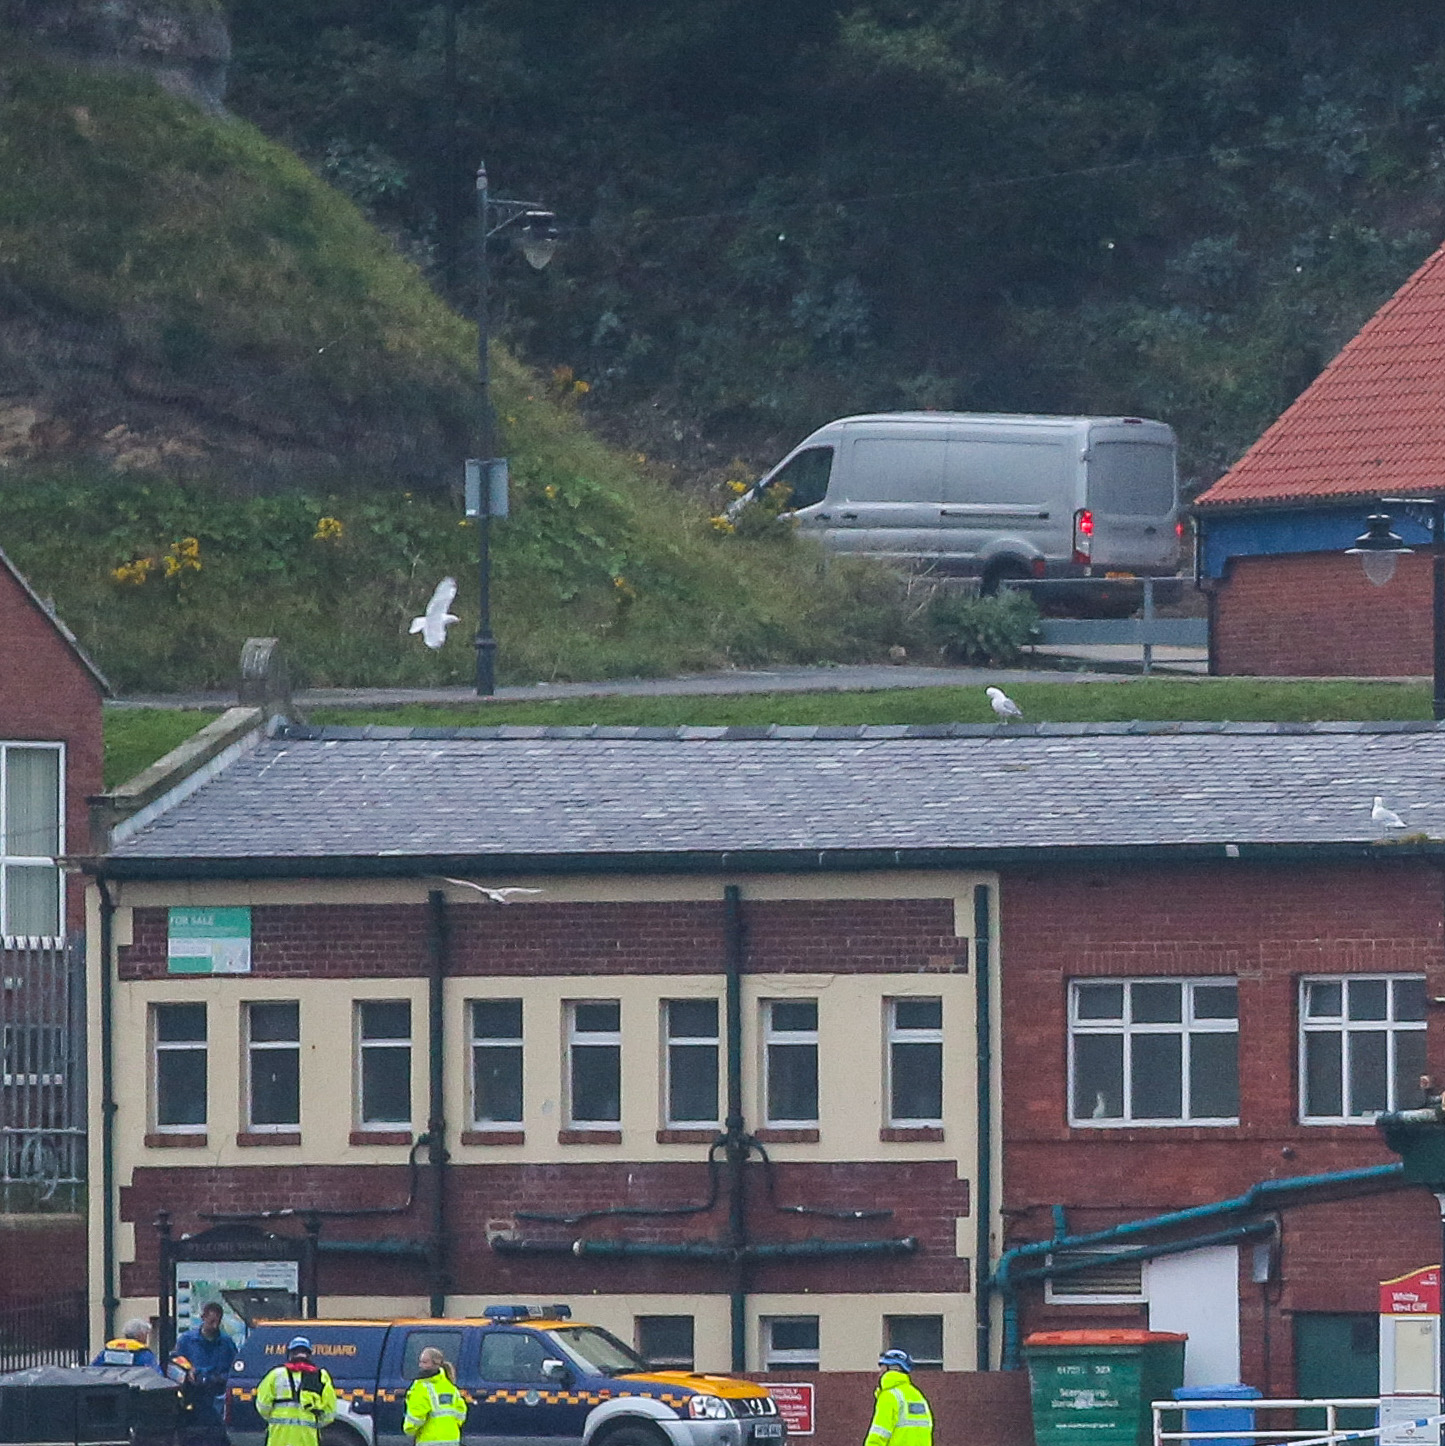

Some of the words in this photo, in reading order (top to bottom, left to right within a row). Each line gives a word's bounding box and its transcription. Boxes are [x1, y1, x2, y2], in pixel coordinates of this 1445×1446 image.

[1391, 1292, 1419, 1302] Whitby
[1392, 1303, 1411, 1312] West
[264, 1344, 274, 1355] H
